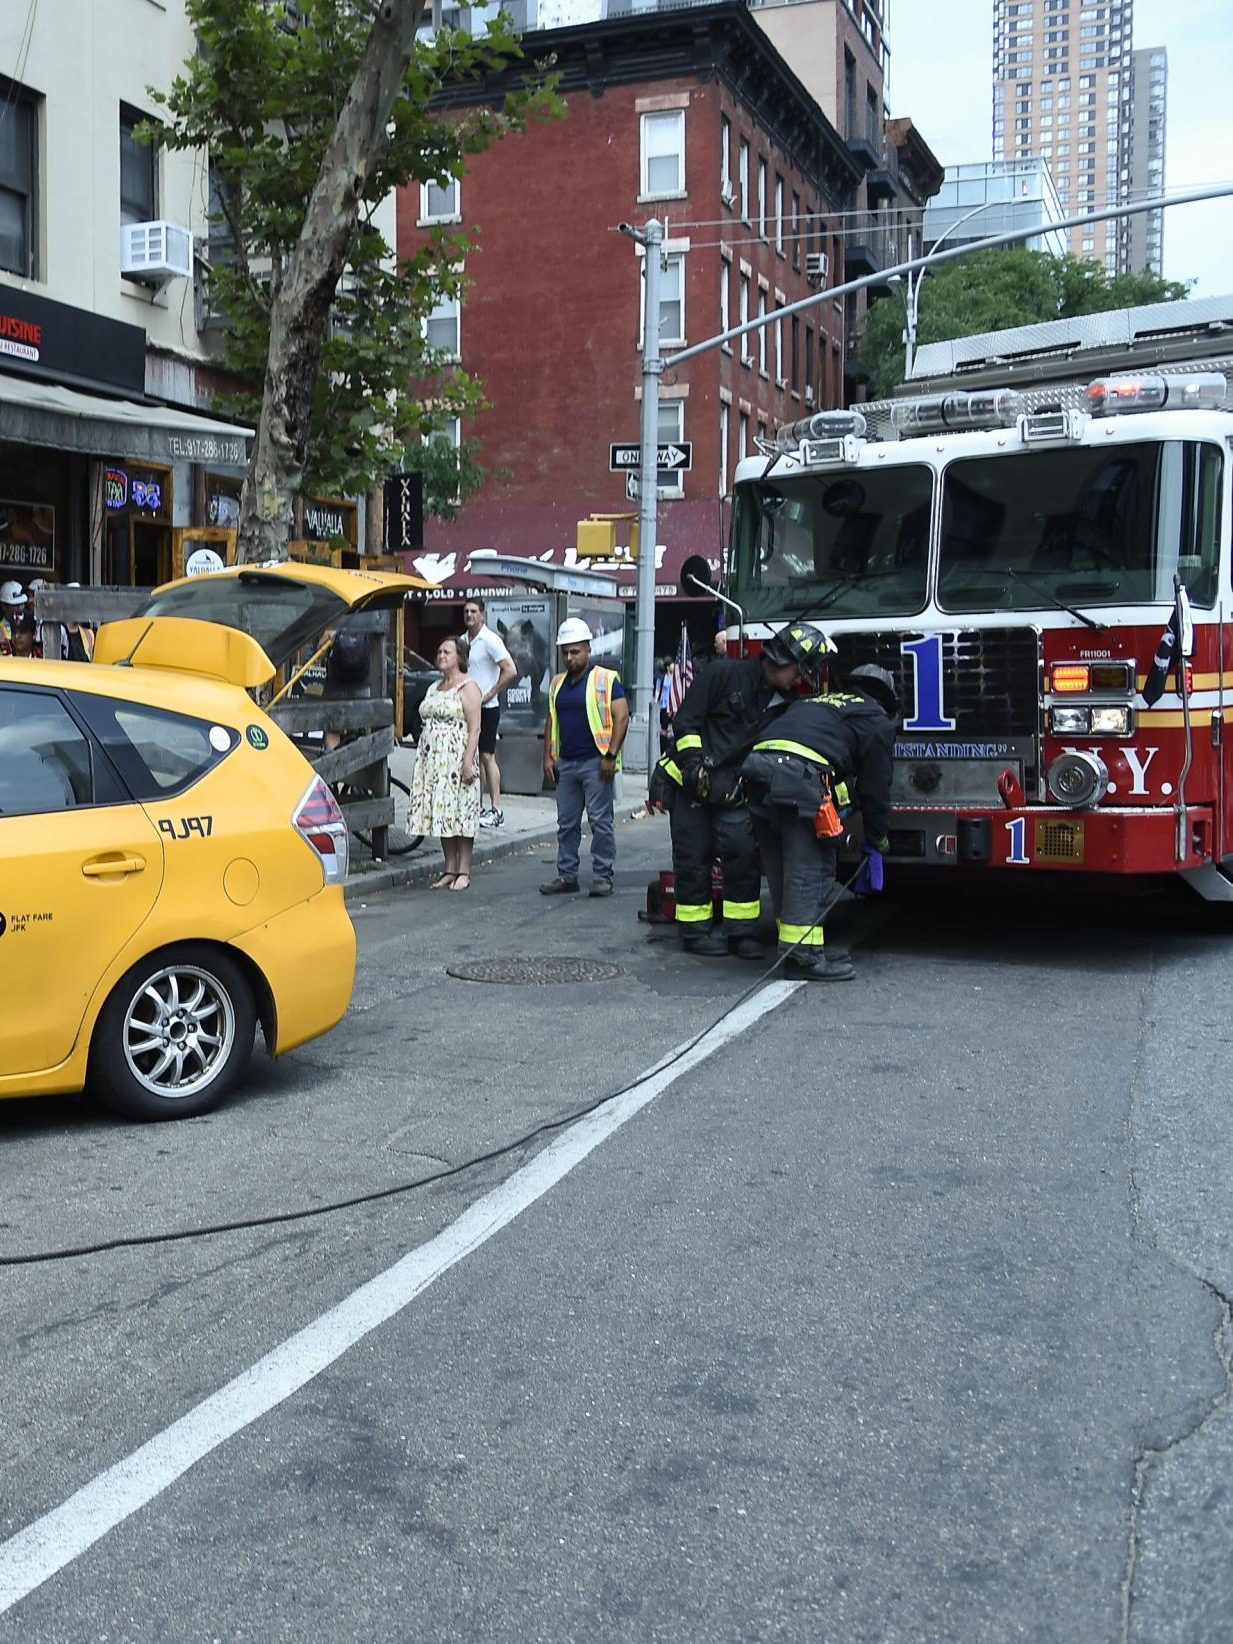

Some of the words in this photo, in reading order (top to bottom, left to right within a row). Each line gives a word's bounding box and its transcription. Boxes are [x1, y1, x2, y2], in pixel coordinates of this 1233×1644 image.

[900, 633, 957, 731] 1
[158, 816, 213, 840] 9J97
[1005, 817, 1030, 864] 1
[11, 913, 30, 924] FLAT
[32, 912, 53, 922] FARE
